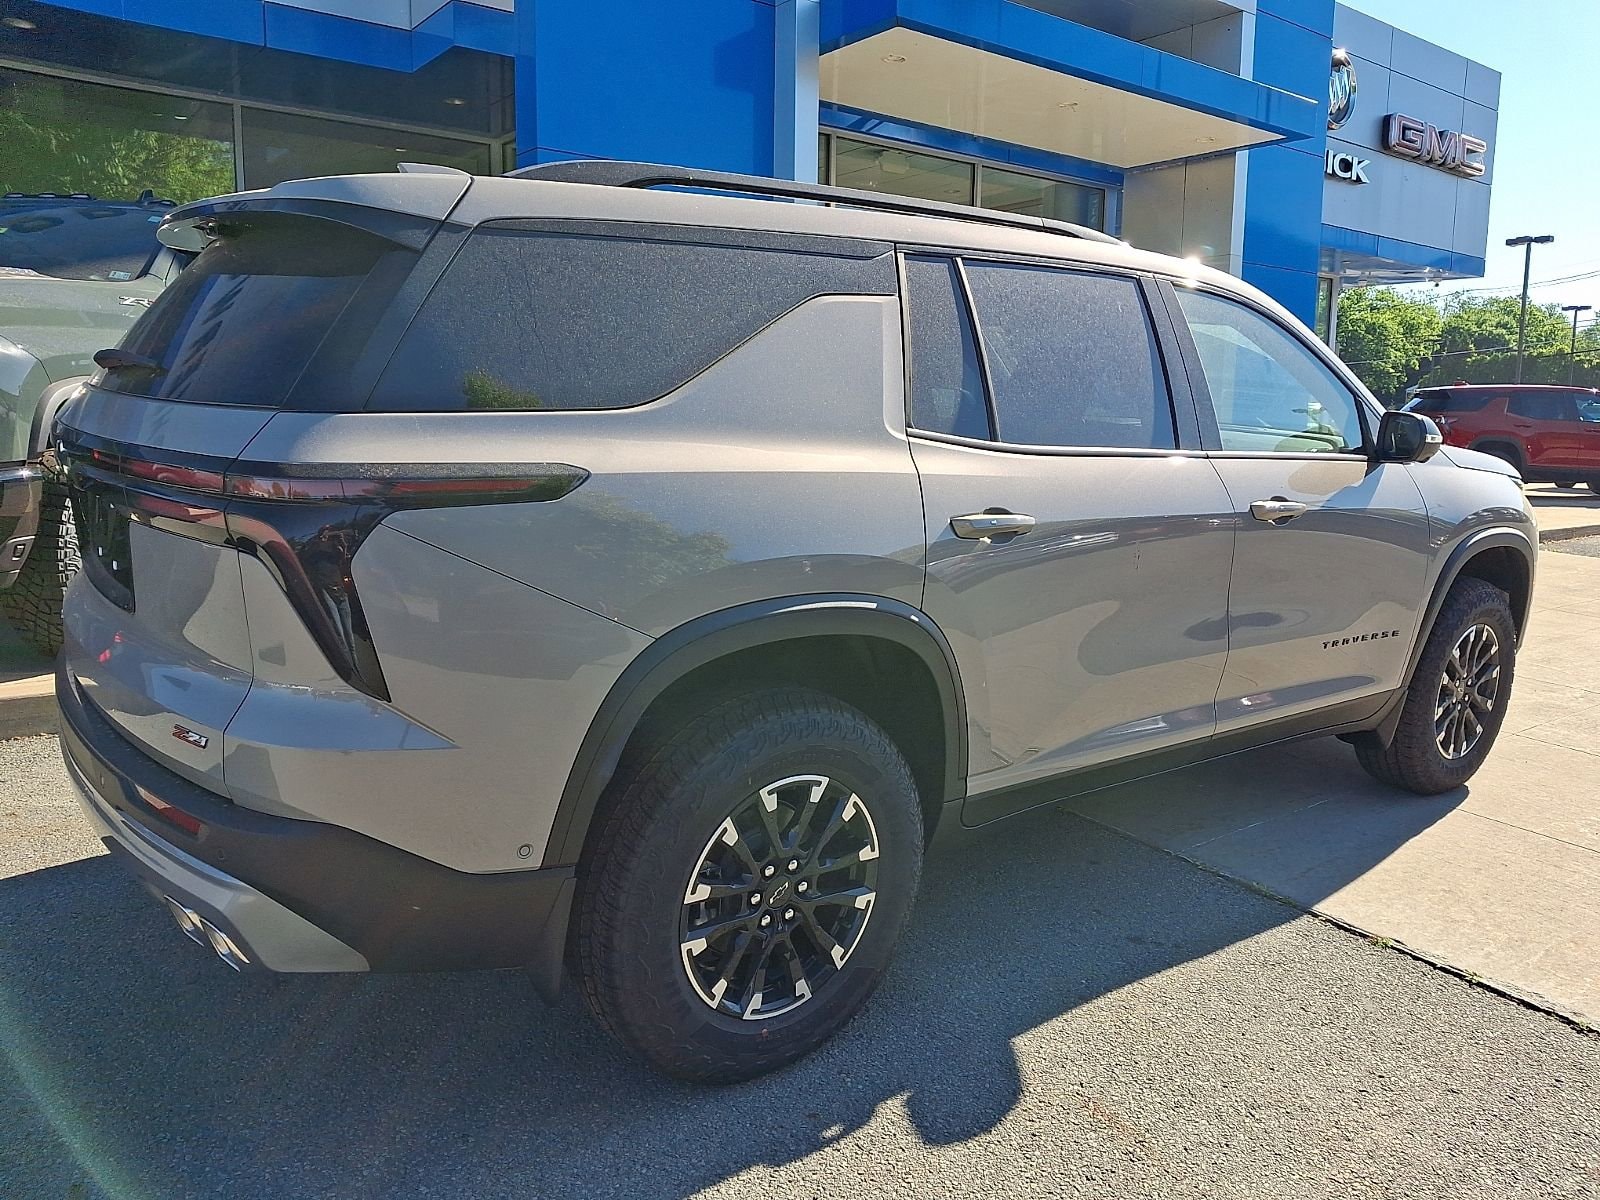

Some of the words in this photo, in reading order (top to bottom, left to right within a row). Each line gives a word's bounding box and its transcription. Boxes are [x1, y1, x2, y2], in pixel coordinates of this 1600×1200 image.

[1383, 113, 1487, 176] GMC
[1324, 149, 1370, 184] ICK
[1322, 630, 1400, 650] TRAVERSE
[172, 723, 209, 749] Z71
